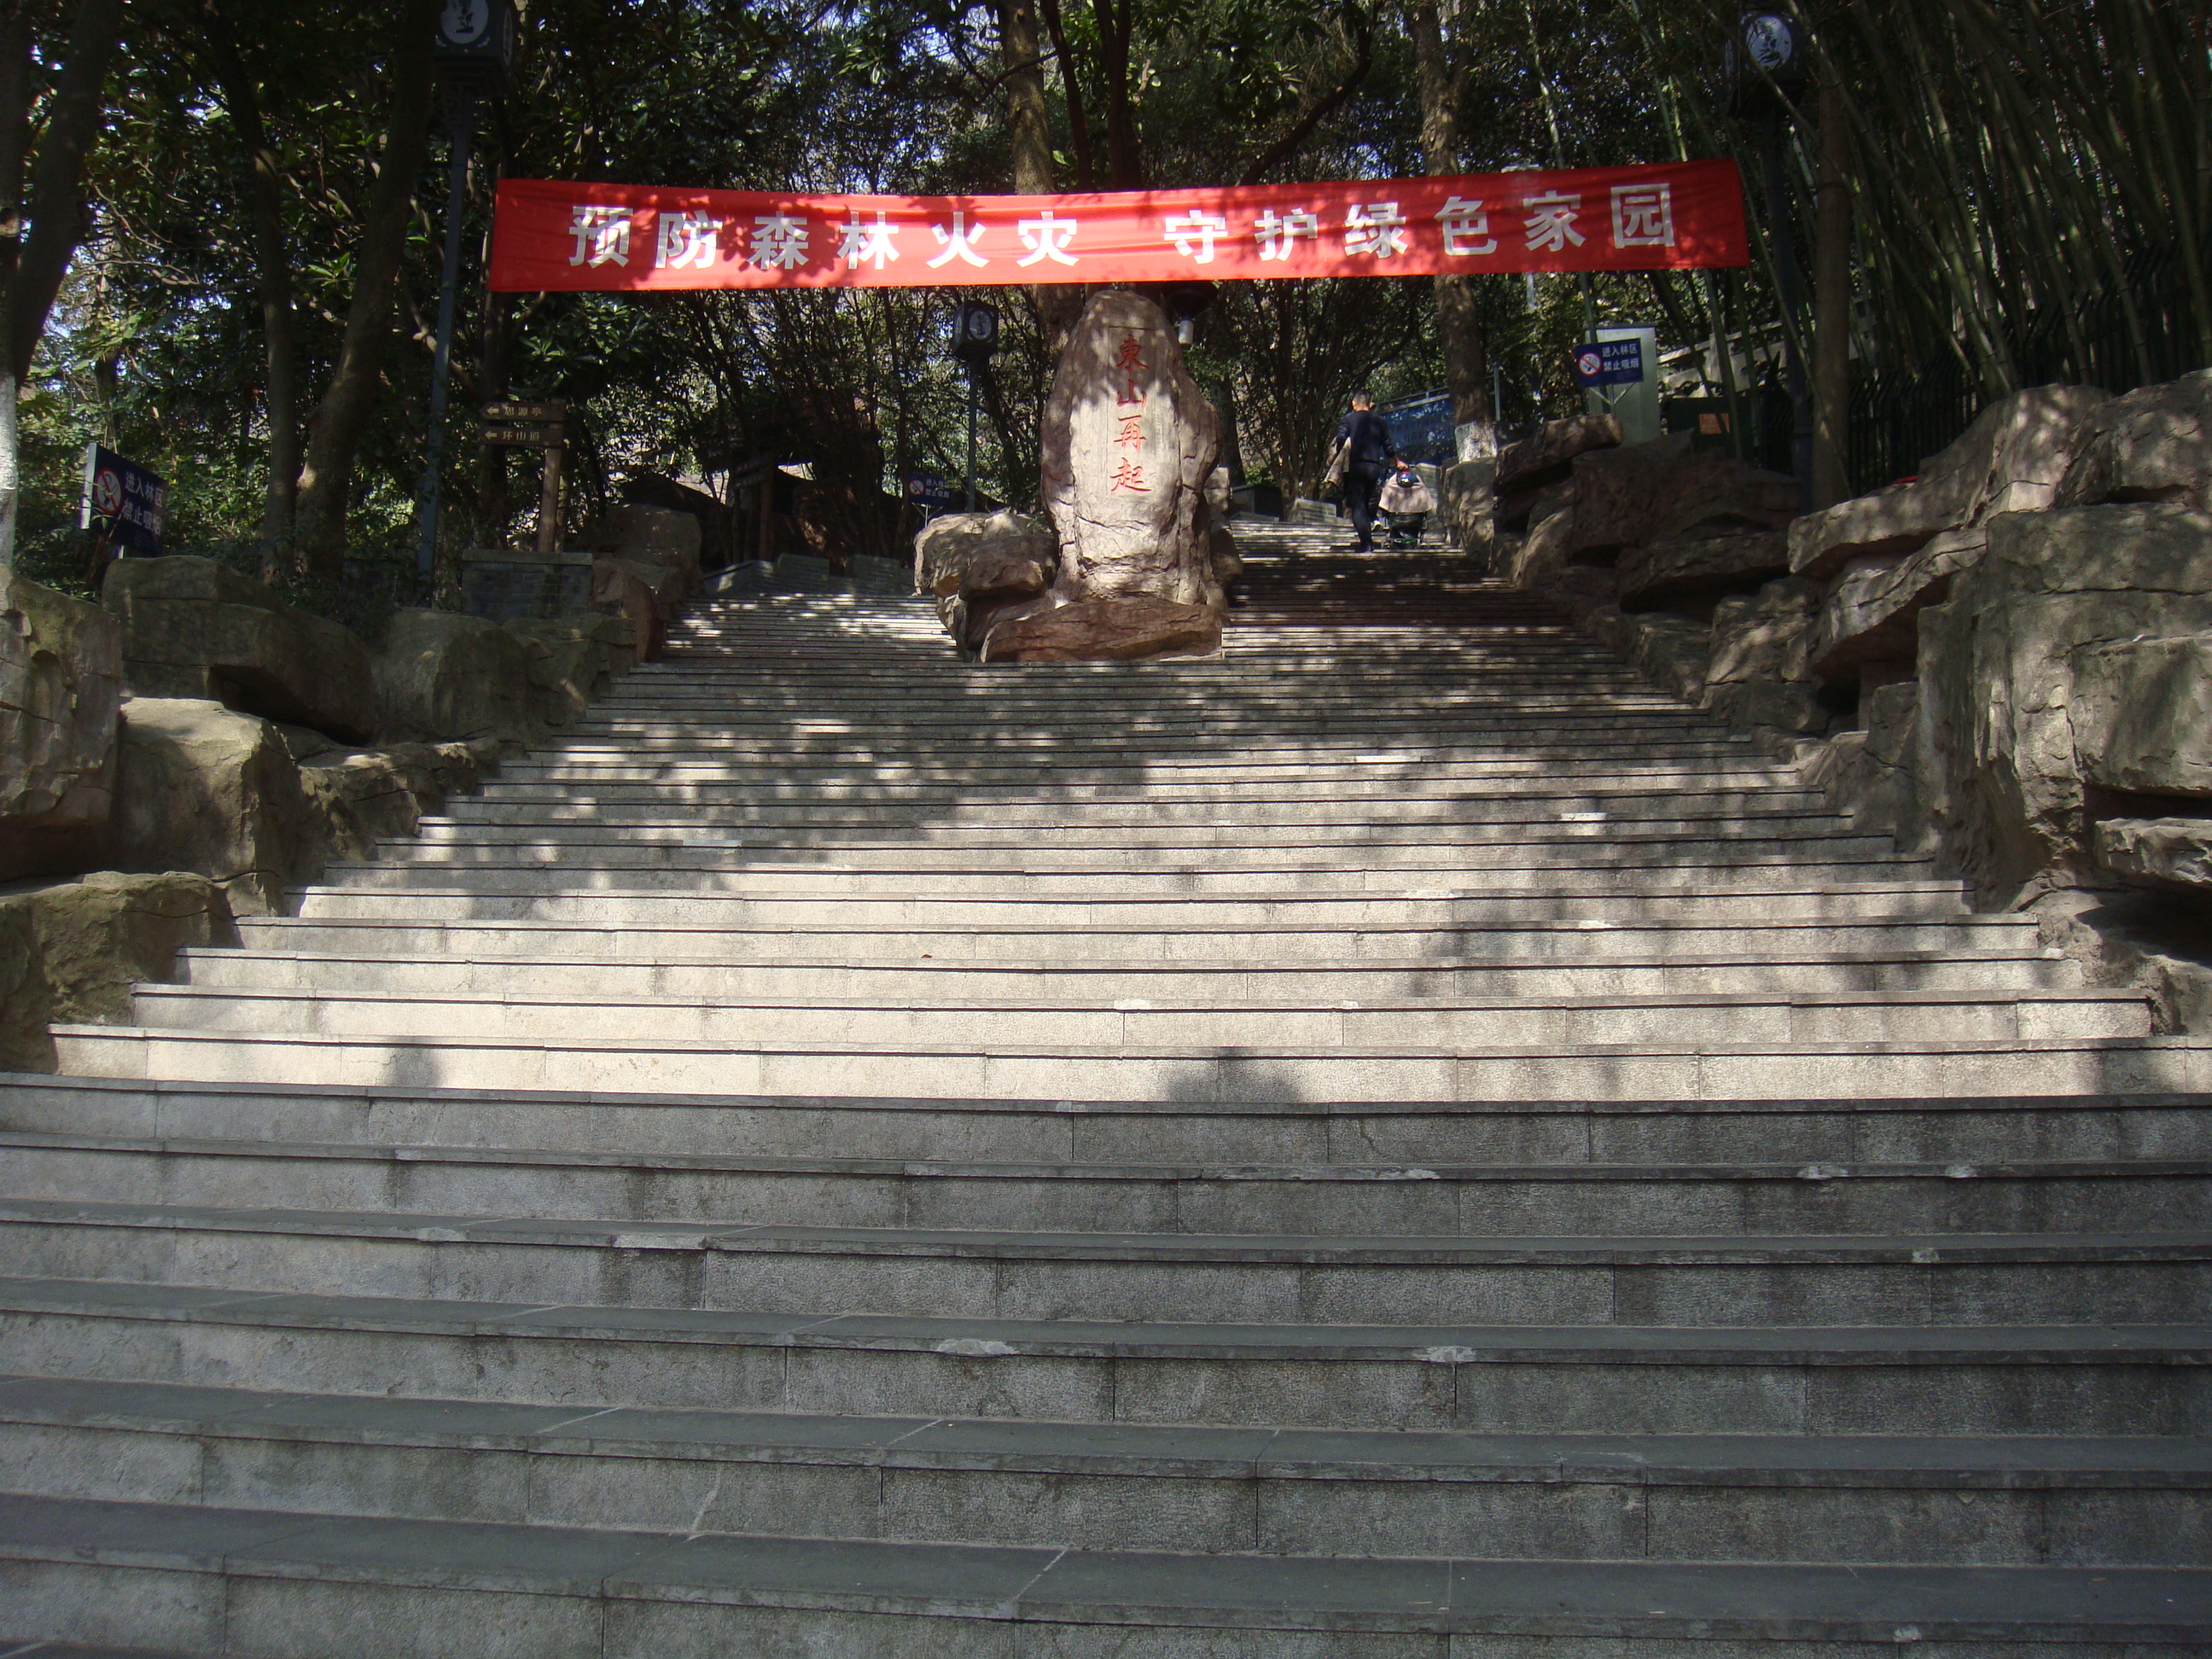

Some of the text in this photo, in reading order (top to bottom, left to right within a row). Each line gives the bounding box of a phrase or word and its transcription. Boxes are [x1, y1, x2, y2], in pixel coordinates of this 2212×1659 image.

[569, 182, 1675, 271] 预防森林火灾 守护绿色家园
[1603, 343, 1638, 358] 进入林区
[1604, 358, 1639, 372] 禁止吸烟
[1110, 333, 1152, 492] 東山再起
[502, 431, 539, 441] 环山道
[125, 471, 163, 508] 进入林区
[123, 498, 162, 536] 禁止吸烟
